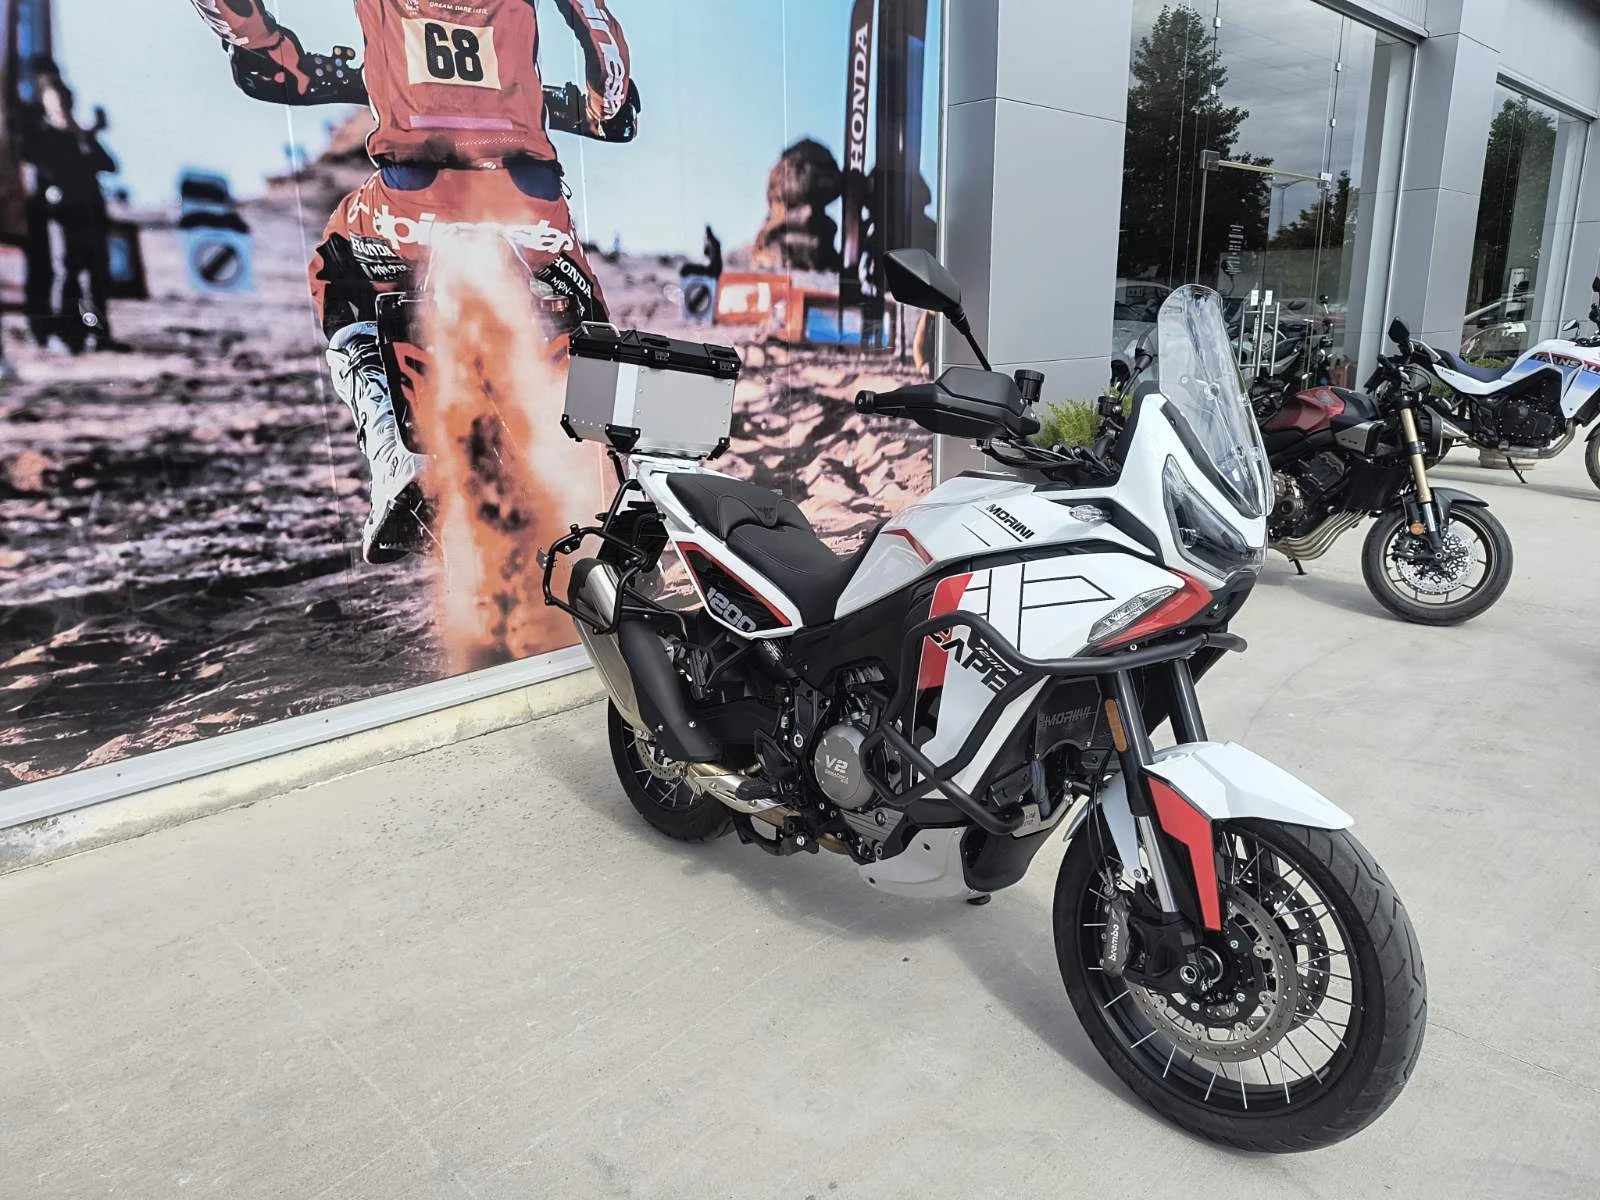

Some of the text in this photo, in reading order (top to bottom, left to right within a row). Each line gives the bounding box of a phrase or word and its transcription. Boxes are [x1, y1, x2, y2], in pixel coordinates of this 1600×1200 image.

[424, 22, 484, 82] 68
[850, 22, 869, 173] HONDA
[552, 256, 592, 300] HONDA
[985, 503, 1036, 540] MORINI
[706, 586, 757, 632] 1200
[825, 754, 849, 774] V2
[1107, 924, 1120, 962] brembo
